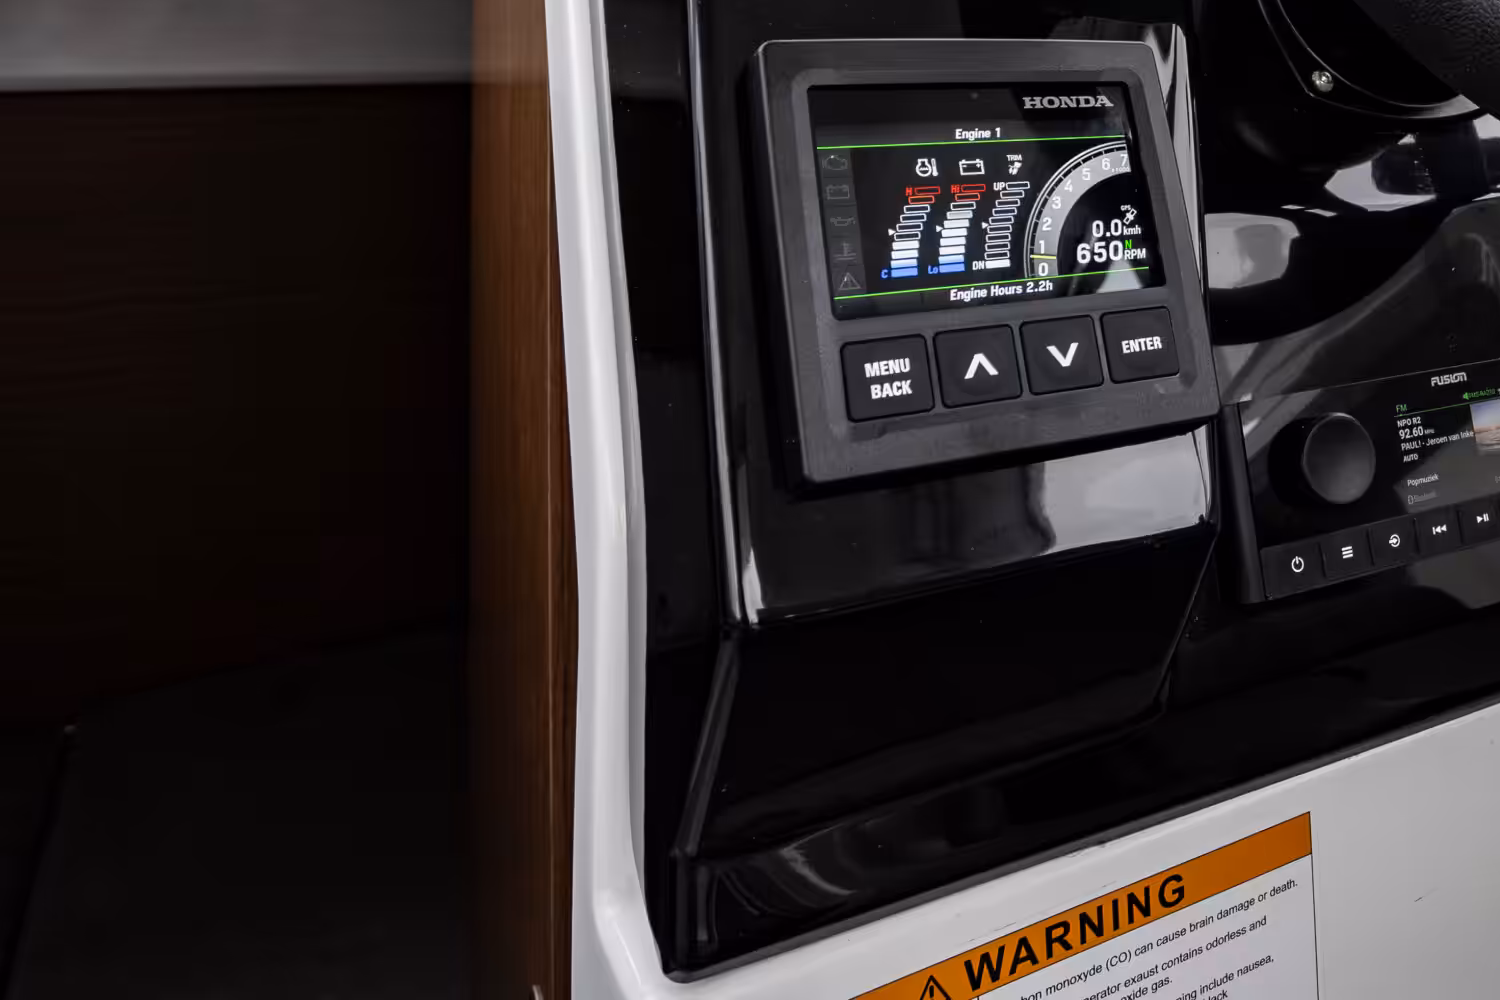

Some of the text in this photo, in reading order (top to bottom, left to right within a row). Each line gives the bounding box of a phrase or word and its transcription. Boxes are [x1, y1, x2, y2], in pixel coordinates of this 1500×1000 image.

[1022, 95, 1114, 109] HONDA
[955, 127, 1001, 141] Engine 1
[1006, 154, 1022, 162] TRIM
[1101, 158, 1111, 171] 6
[1120, 153, 1129, 166] 7
[1082, 168, 1091, 181] 5
[905, 187, 913, 196] H
[951, 185, 961, 194] Hi
[993, 183, 1006, 191] UP
[1064, 179, 1073, 193] 4
[1051, 196, 1061, 209] 3
[1042, 217, 1052, 231] 2
[1092, 219, 1122, 238] 0.0
[1039, 240, 1045, 254] 1
[1124, 239, 1132, 249] N
[1076, 240, 1124, 264] 650
[1124, 248, 1146, 260] RPM
[928, 265, 939, 274] Lo
[972, 261, 985, 270] DN
[1038, 262, 1049, 276] 0
[881, 269, 889, 278] C
[950, 281, 1053, 302] Engine Hours 2.2h
[1121, 336, 1163, 354] ENTER
[864, 357, 911, 378] MENU
[1431, 372, 1467, 387] FUSION
[870, 379, 913, 400] BACK
[1396, 404, 1408, 413] FM
[1397, 416, 1422, 428] NPO R2
[1399, 426, 1424, 440] 92.60
[1401, 441, 1422, 451] PAUL!
[1426, 435, 1448, 447] Jeroen
[1448, 433, 1460, 441] van
[1403, 453, 1419, 463] AUTO
[1407, 473, 1439, 487] Popmuziek
[963, 873, 1185, 992] WARNING
[1045, 964, 1103, 996] monoxyde
[1106, 949, 1132, 972] (CO)
[1134, 941, 1153, 957] can
[1156, 927, 1187, 947] cause
[1189, 916, 1214, 933] brain
[1216, 897, 1255, 921] damage
[1257, 891, 1268, 903] or
[1269, 879, 1298, 898] death.
[1123, 964, 1159, 988] exaust
[1161, 946, 1203, 971] contains
[1205, 926, 1247, 951] odorless
[1249, 915, 1267, 931] and
[1199, 972, 1235, 996] include
[1236, 955, 1274, 978] nausea,
[1151, 976, 1173, 993] gas.
